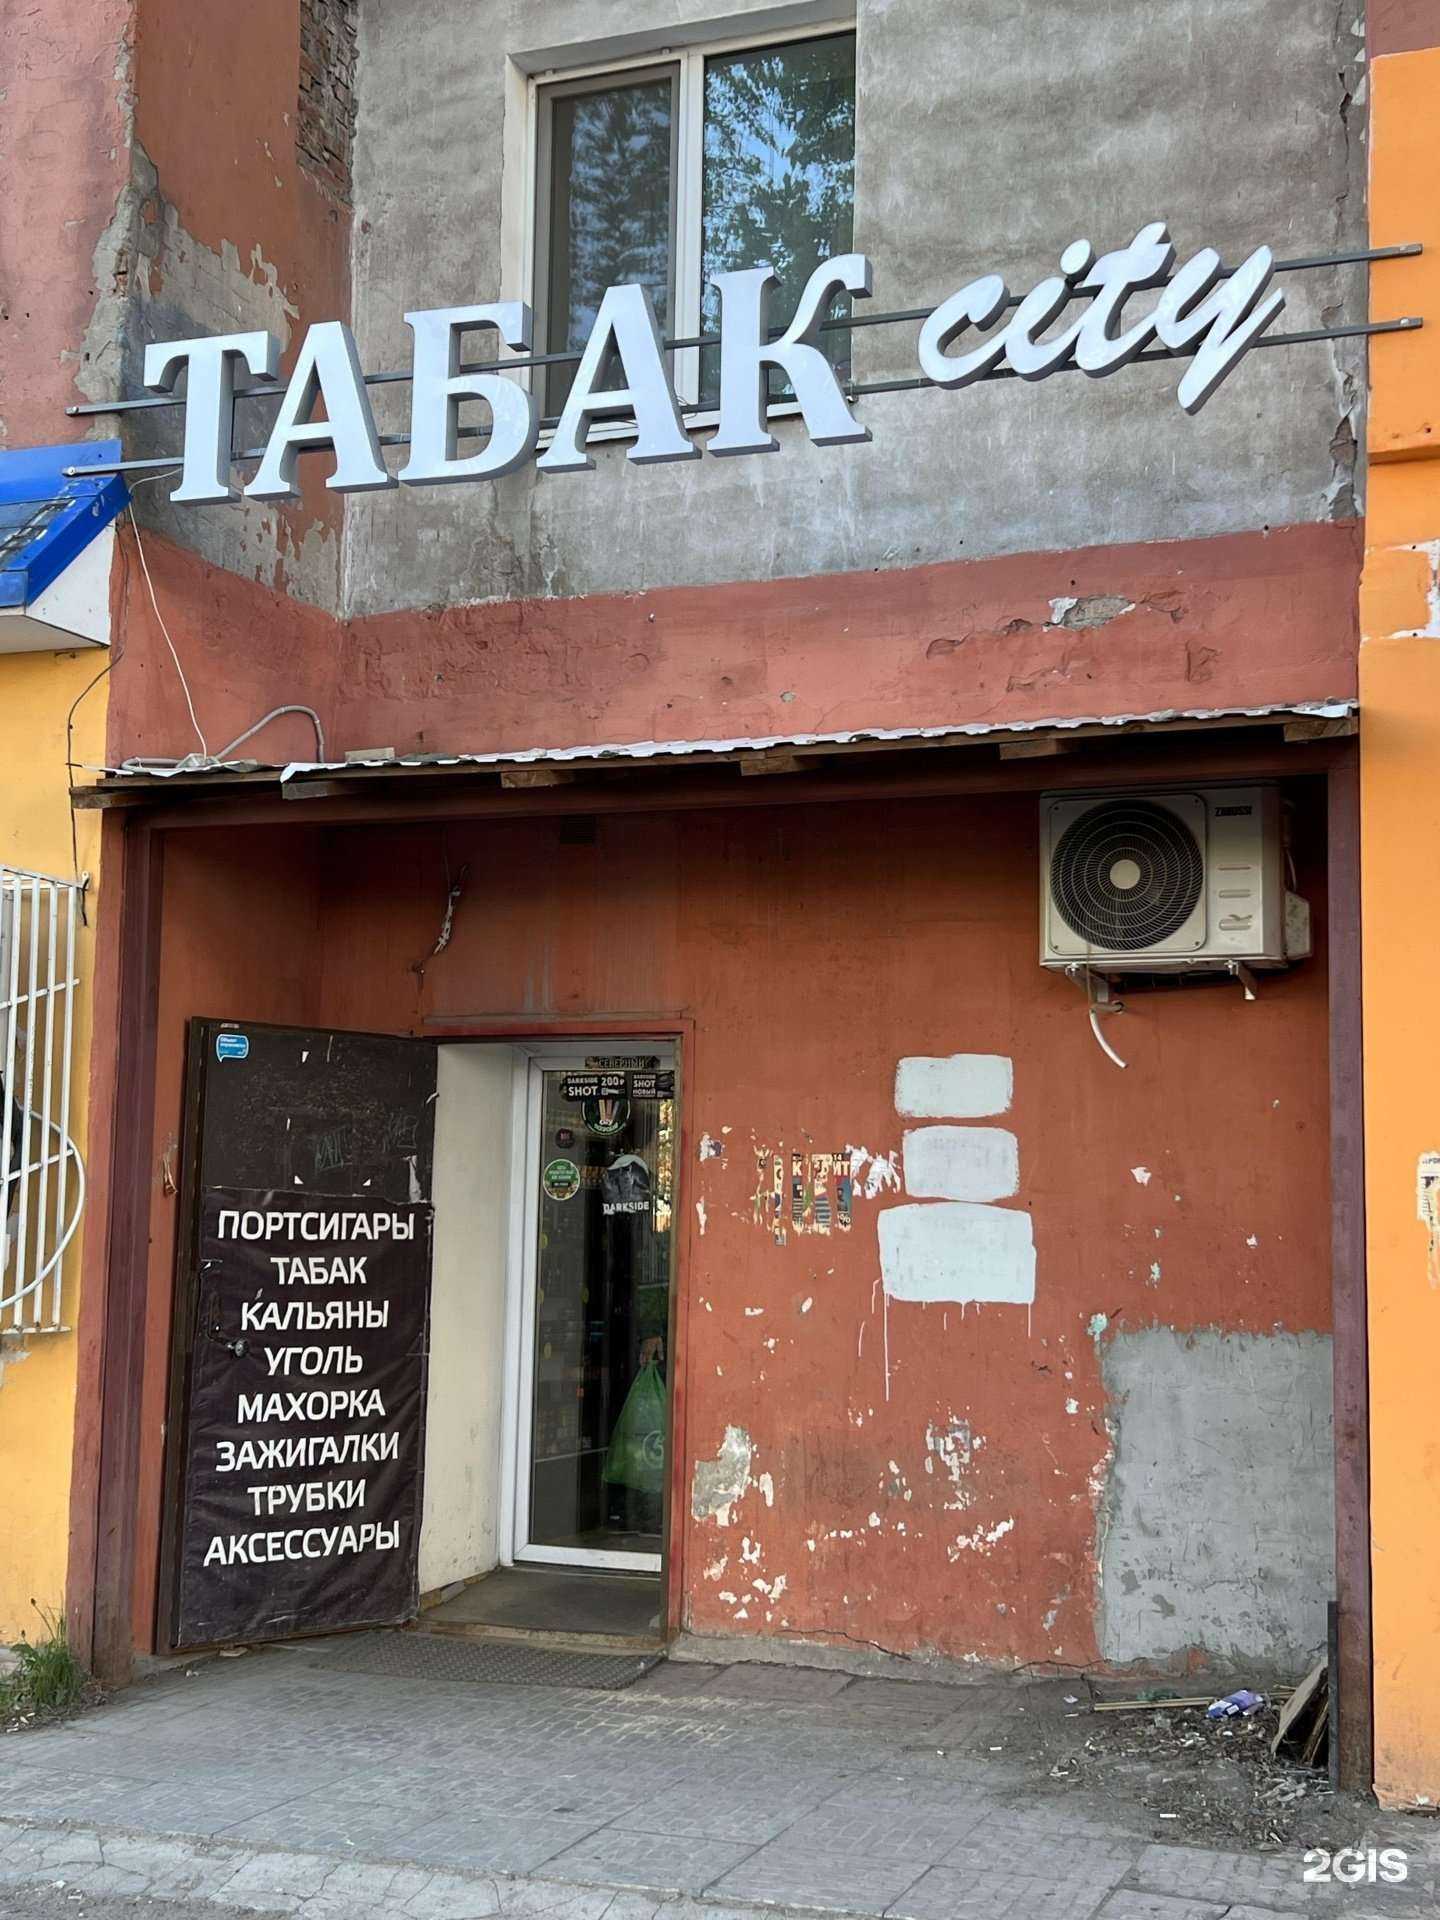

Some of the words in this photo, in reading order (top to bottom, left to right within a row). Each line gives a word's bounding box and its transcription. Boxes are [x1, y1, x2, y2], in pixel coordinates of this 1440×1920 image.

[143, 253, 873, 503] ТАБАК
[918, 221, 1286, 414] city
[568, 1086, 598, 1097] SHOT
[633, 1080, 656, 1088] SHOT
[602, 1201, 650, 1216] DARKSIDE
[217, 1210, 415, 1241] ПОРТСИГАРЫ
[270, 1256, 368, 1286] ТАБАК
[240, 1300, 390, 1331] КАЛЬЯНЫ
[264, 1345, 363, 1376] УГОЛЬ
[237, 1388, 386, 1424] МАХОРКА
[215, 1431, 400, 1472] ЗАЖИГАЛКИ
[247, 1479, 367, 1516] ТРУБКИ
[203, 1520, 400, 1567] АКСЕССУАРЫ
